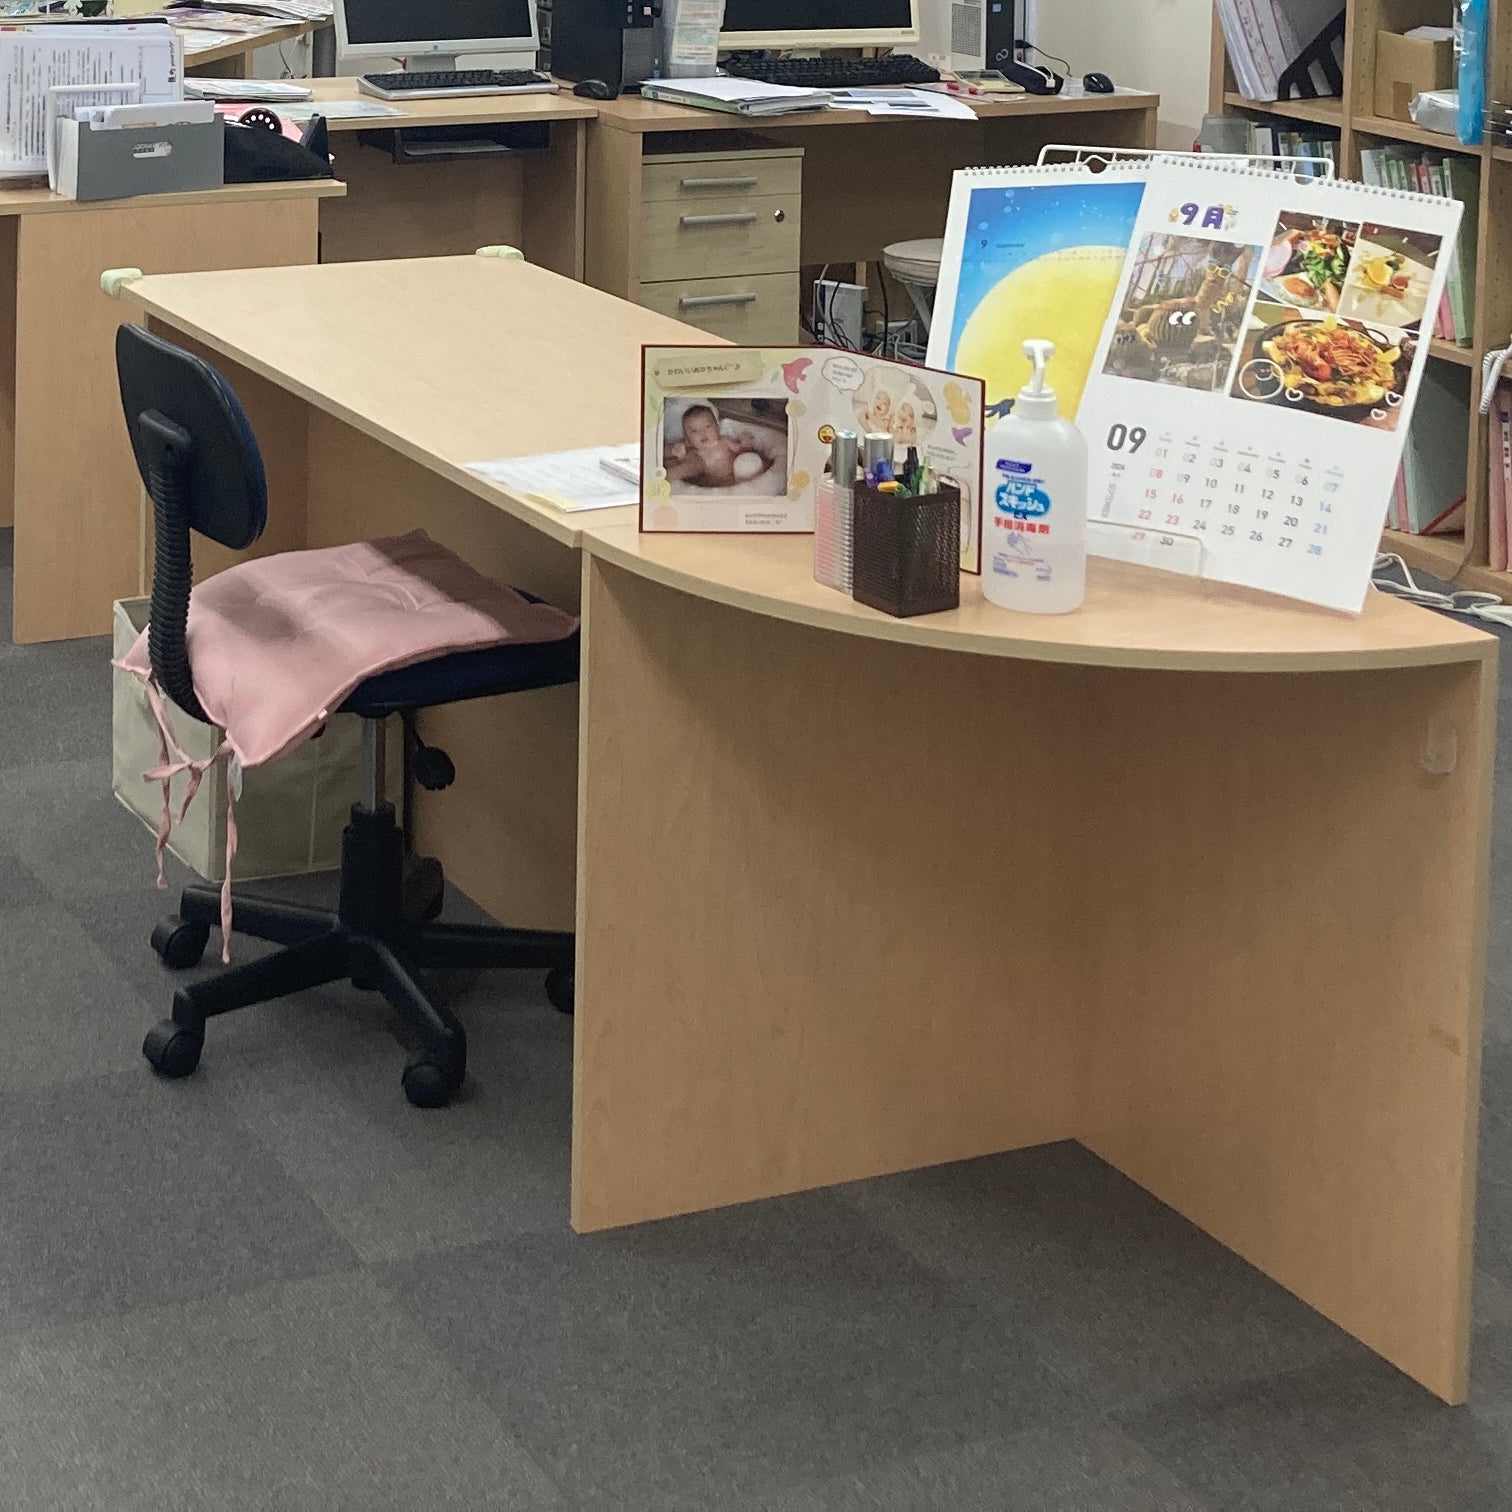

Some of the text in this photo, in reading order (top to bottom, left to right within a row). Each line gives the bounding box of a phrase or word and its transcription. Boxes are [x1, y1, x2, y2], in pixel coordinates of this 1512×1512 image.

[1180, 202, 1224, 230] 9月
[1106, 423, 1147, 454] 09
[1182, 452, 1196, 464] 02
[1210, 457, 1224, 468] 03
[1295, 474, 1309, 486] 06
[1145, 488, 1328, 535] 15 16 17 18 19 20 21
[1205, 478, 1218, 489] 10
[1234, 483, 1245, 494] 11
[1261, 488, 1274, 500] 12
[1290, 495, 1304, 507] 13
[1319, 501, 1332, 513] 14
[1138, 509, 1322, 556] 22 23 24 25 26 27 28
[1159, 535, 1174, 546] 30
